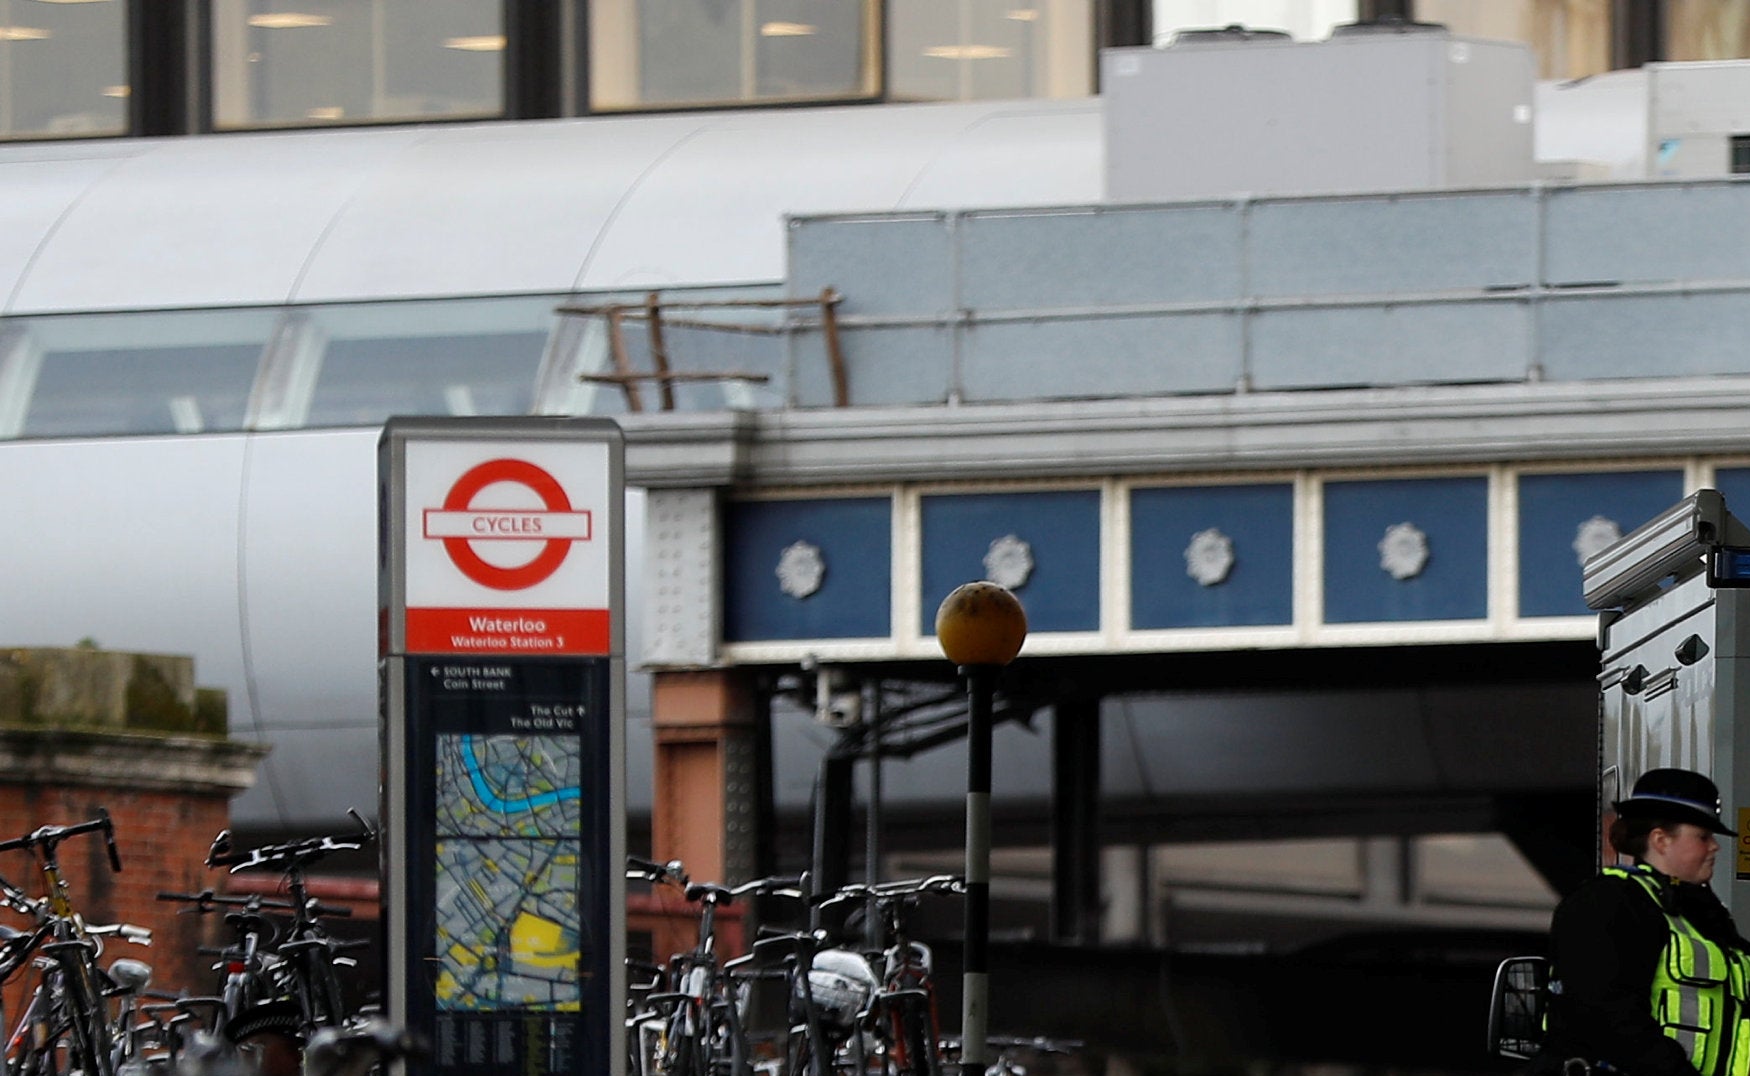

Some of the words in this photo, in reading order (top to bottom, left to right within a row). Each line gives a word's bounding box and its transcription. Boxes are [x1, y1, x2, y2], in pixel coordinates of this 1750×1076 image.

[472, 517, 542, 533] CYCLES
[469, 616, 546, 633] Waterloo
[450, 636, 507, 649] Waterloo
[510, 636, 553, 649] Station
[556, 637, 564, 648] 3
[443, 666, 480, 677] SOUTH
[482, 667, 512, 677] BANK
[443, 679, 469, 689] Coin
[471, 679, 505, 690] Street
[531, 705, 551, 715] The
[553, 705, 573, 716] Cut
[511, 717, 531, 728] The
[533, 718, 553, 728] Old
[556, 718, 574, 729] Vic
